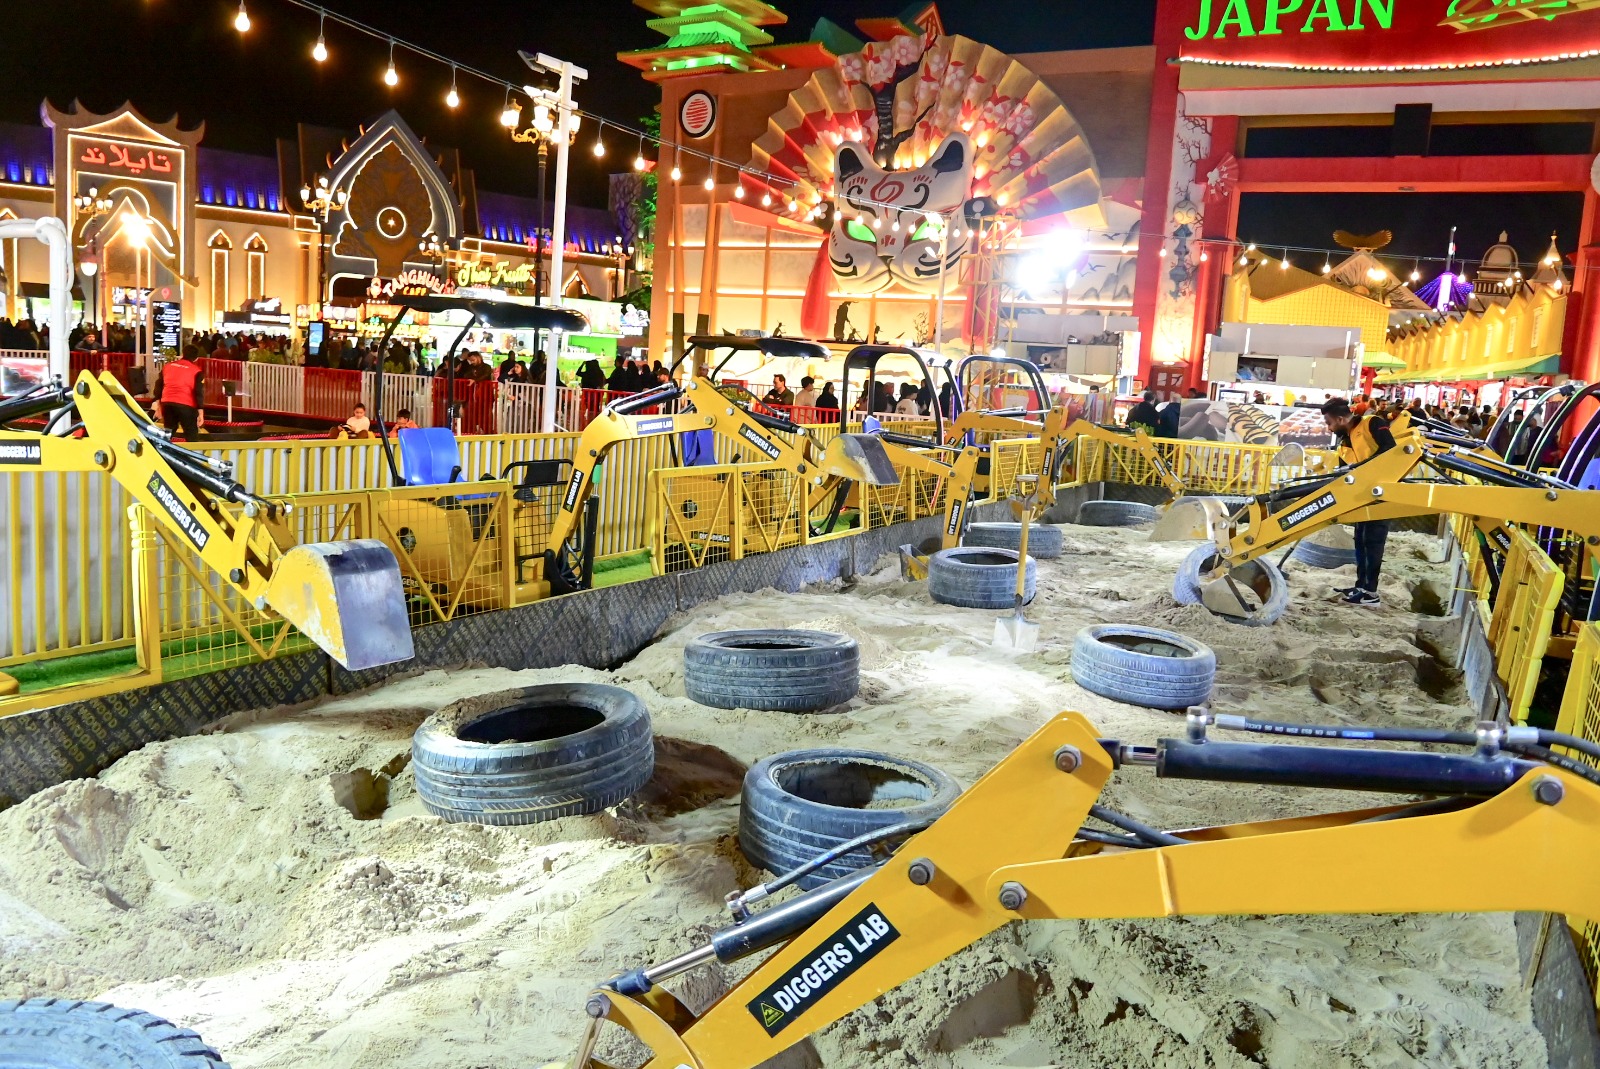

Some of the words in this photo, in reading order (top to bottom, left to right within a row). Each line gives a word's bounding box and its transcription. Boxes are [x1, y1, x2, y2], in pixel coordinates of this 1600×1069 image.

[1184, 0, 1395, 40] JAPAN
[80, 145, 172, 173] تايلاند
[457, 260, 491, 287] Thai
[663, 420, 673, 429] LAB
[26, 446, 41, 458] LAB
[745, 429, 768, 451] DIGGERS
[767, 445, 779, 459] LAB
[574, 470, 582, 485] LAB
[157, 484, 192, 529] DIGGERS
[188, 521, 207, 547] LAB
[1287, 503, 1319, 525] DIGGERS
[1316, 494, 1334, 513] LAB
[773, 942, 854, 1012] DIGGERS
[846, 913, 890, 953] LAB
